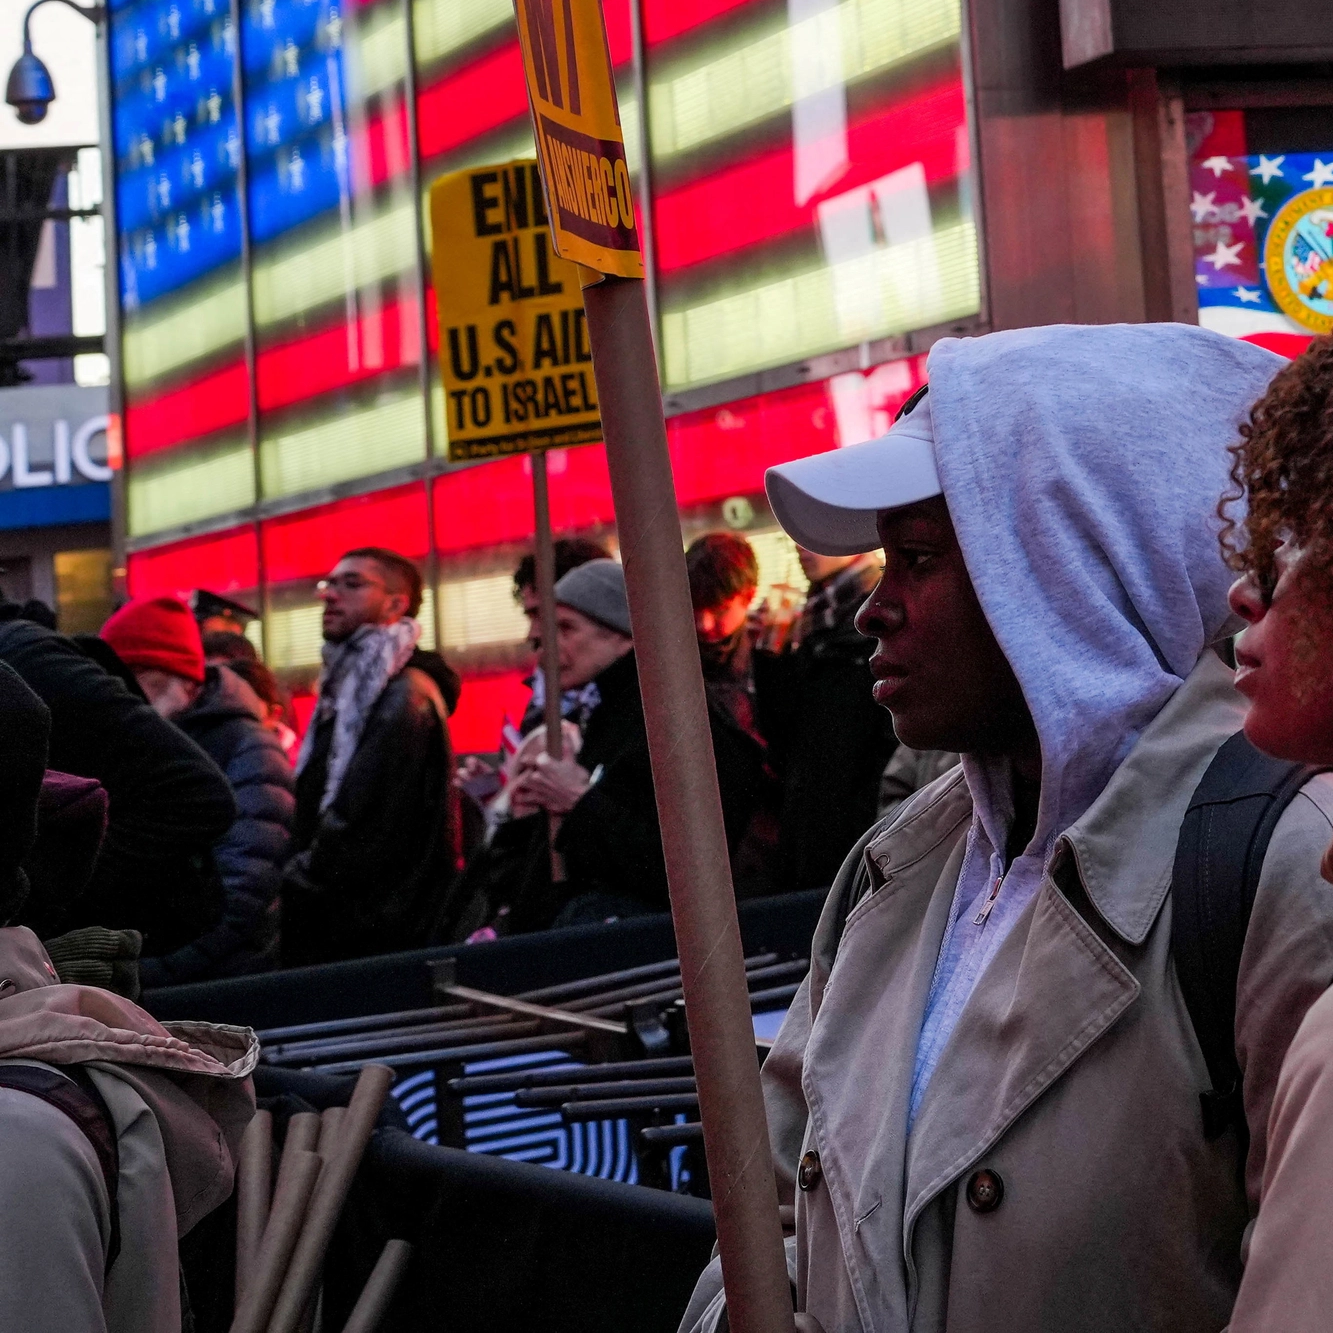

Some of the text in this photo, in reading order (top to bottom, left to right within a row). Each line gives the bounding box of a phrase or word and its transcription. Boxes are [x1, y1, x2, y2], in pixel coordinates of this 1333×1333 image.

[489, 233, 563, 305] ALL
[450, 371, 598, 430] TO ISRAEL
